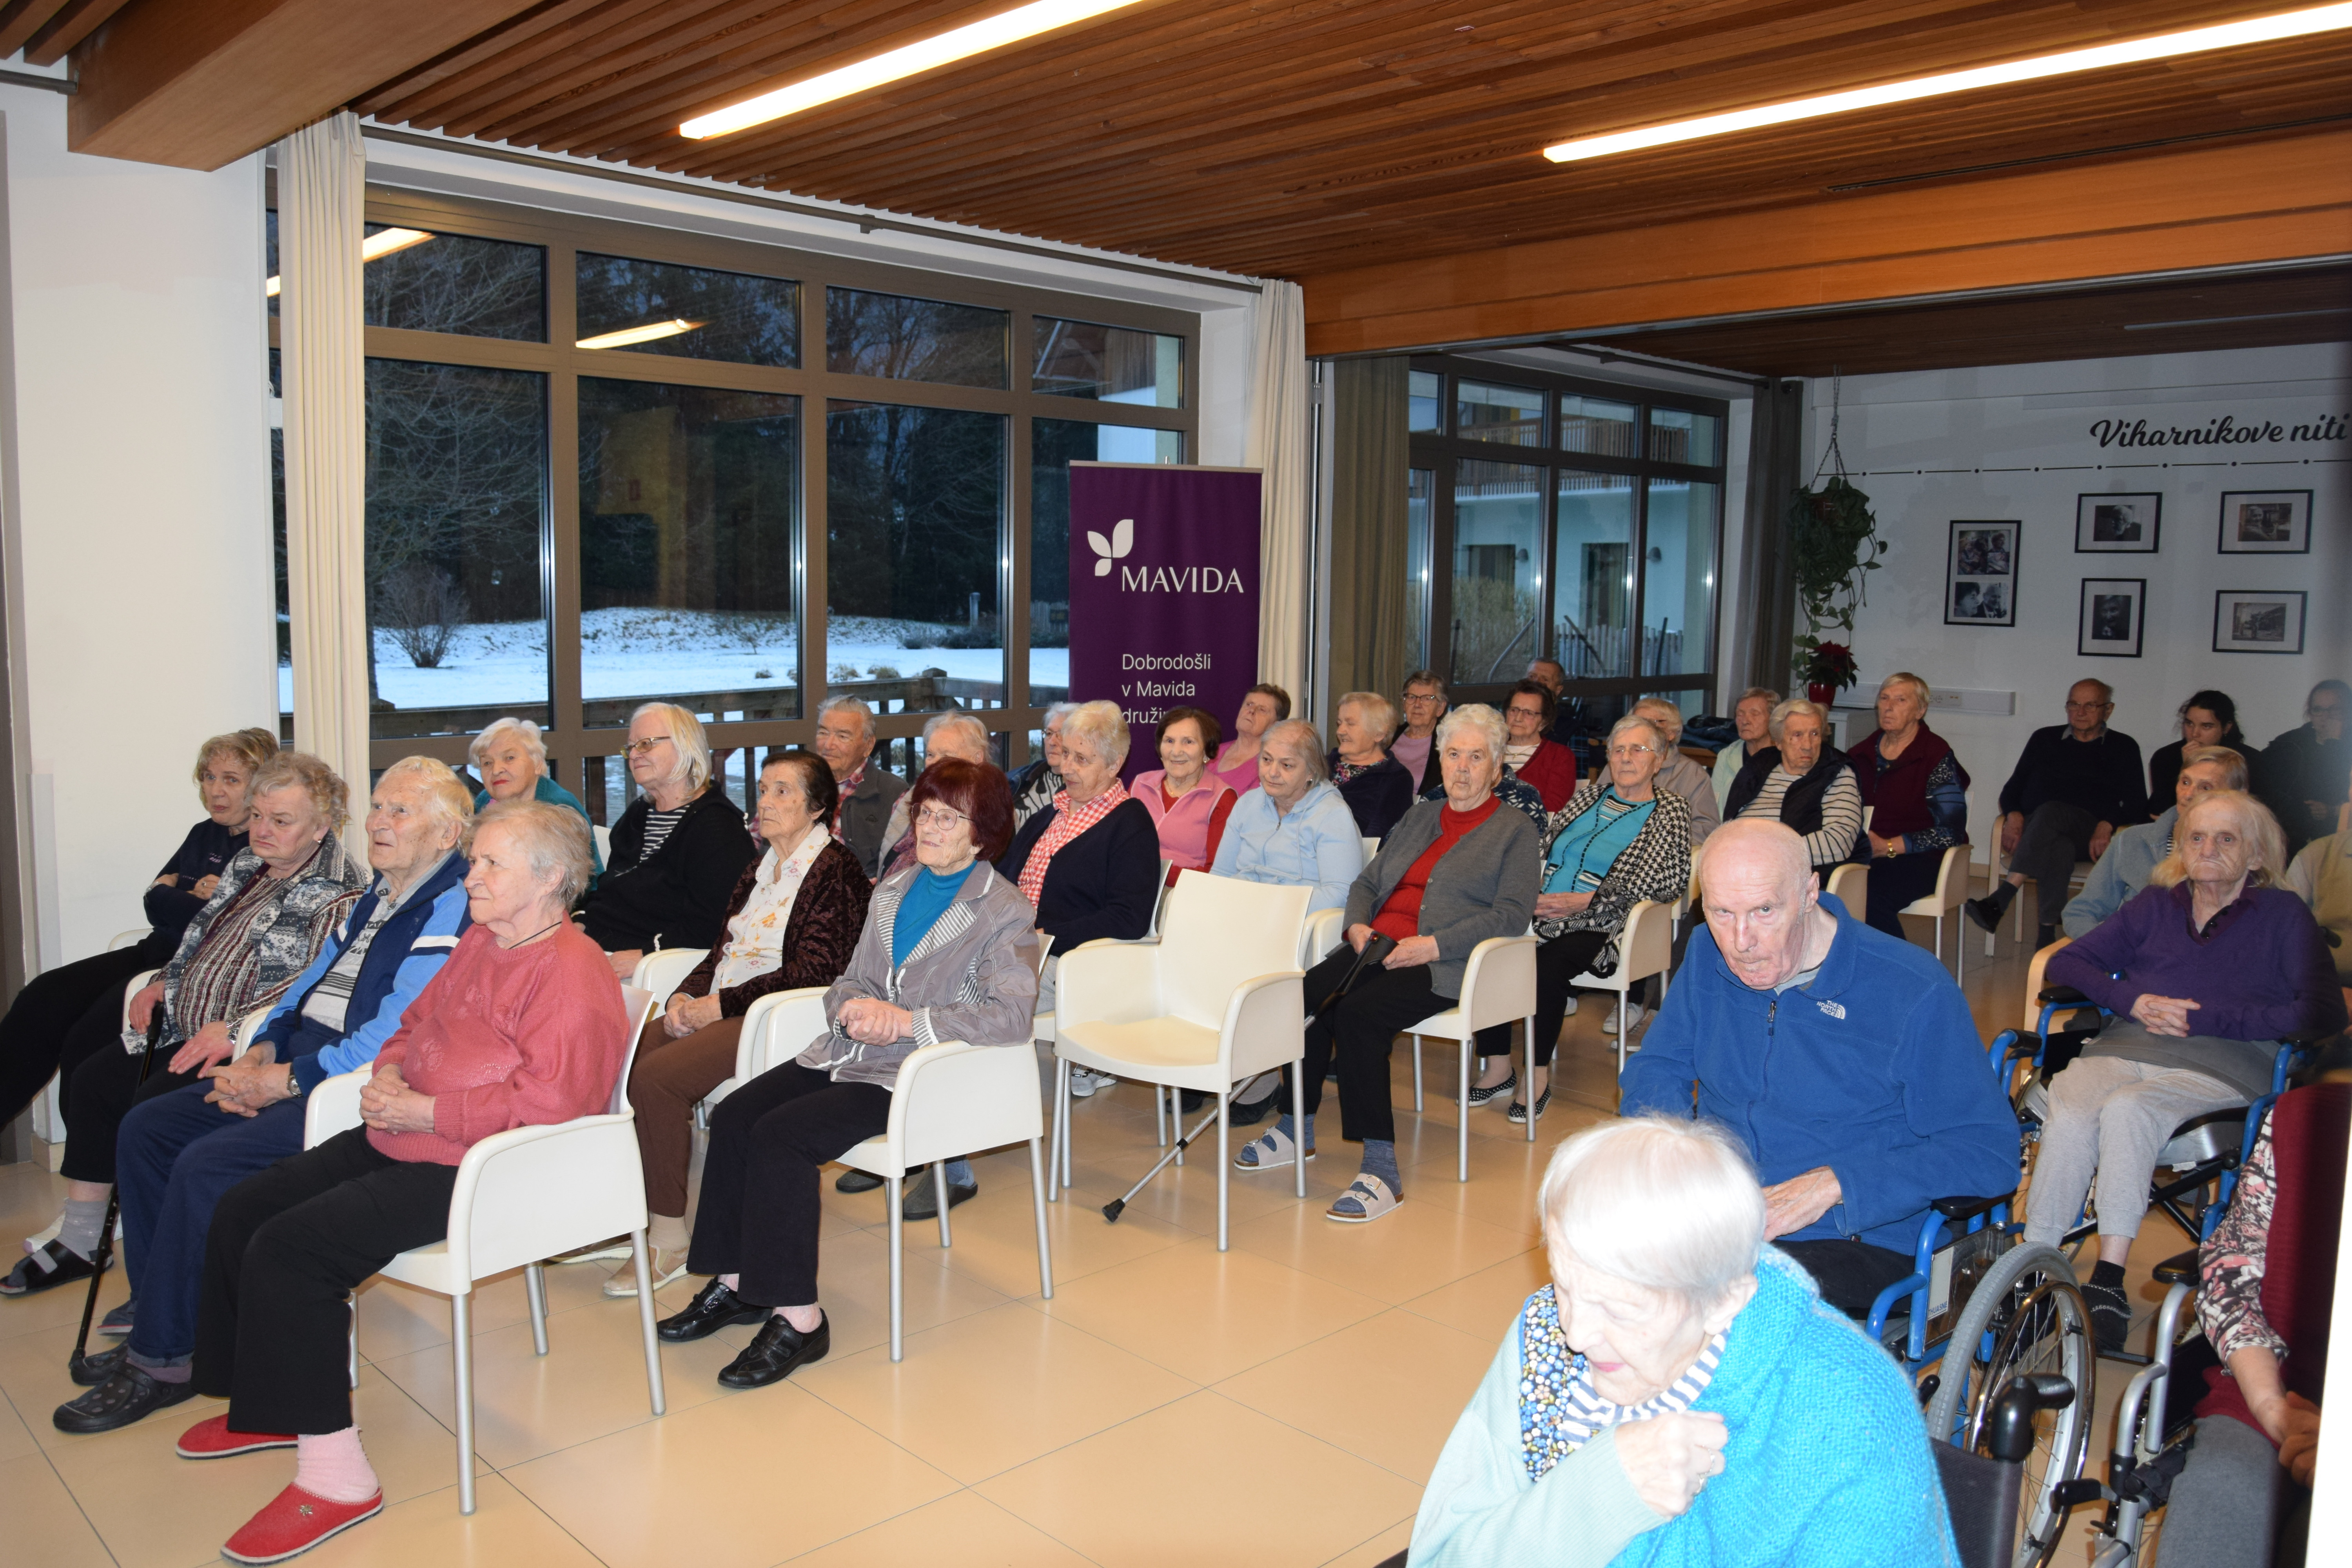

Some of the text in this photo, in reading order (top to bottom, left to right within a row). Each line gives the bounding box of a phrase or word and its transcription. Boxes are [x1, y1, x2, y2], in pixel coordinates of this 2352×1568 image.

[2090, 413, 2350, 448] Viharnikove niti
[1122, 566, 1244, 593] MAVIDA
[1123, 653, 1210, 670] Dobrodošli
[1122, 681, 1195, 697] v Mavida
[1122, 707, 1168, 723] druži
[1816, 1001, 1837, 1012] NORTH
[1820, 1007, 1835, 1016] FACE
[1928, 1301, 1947, 1315] THUASNE
